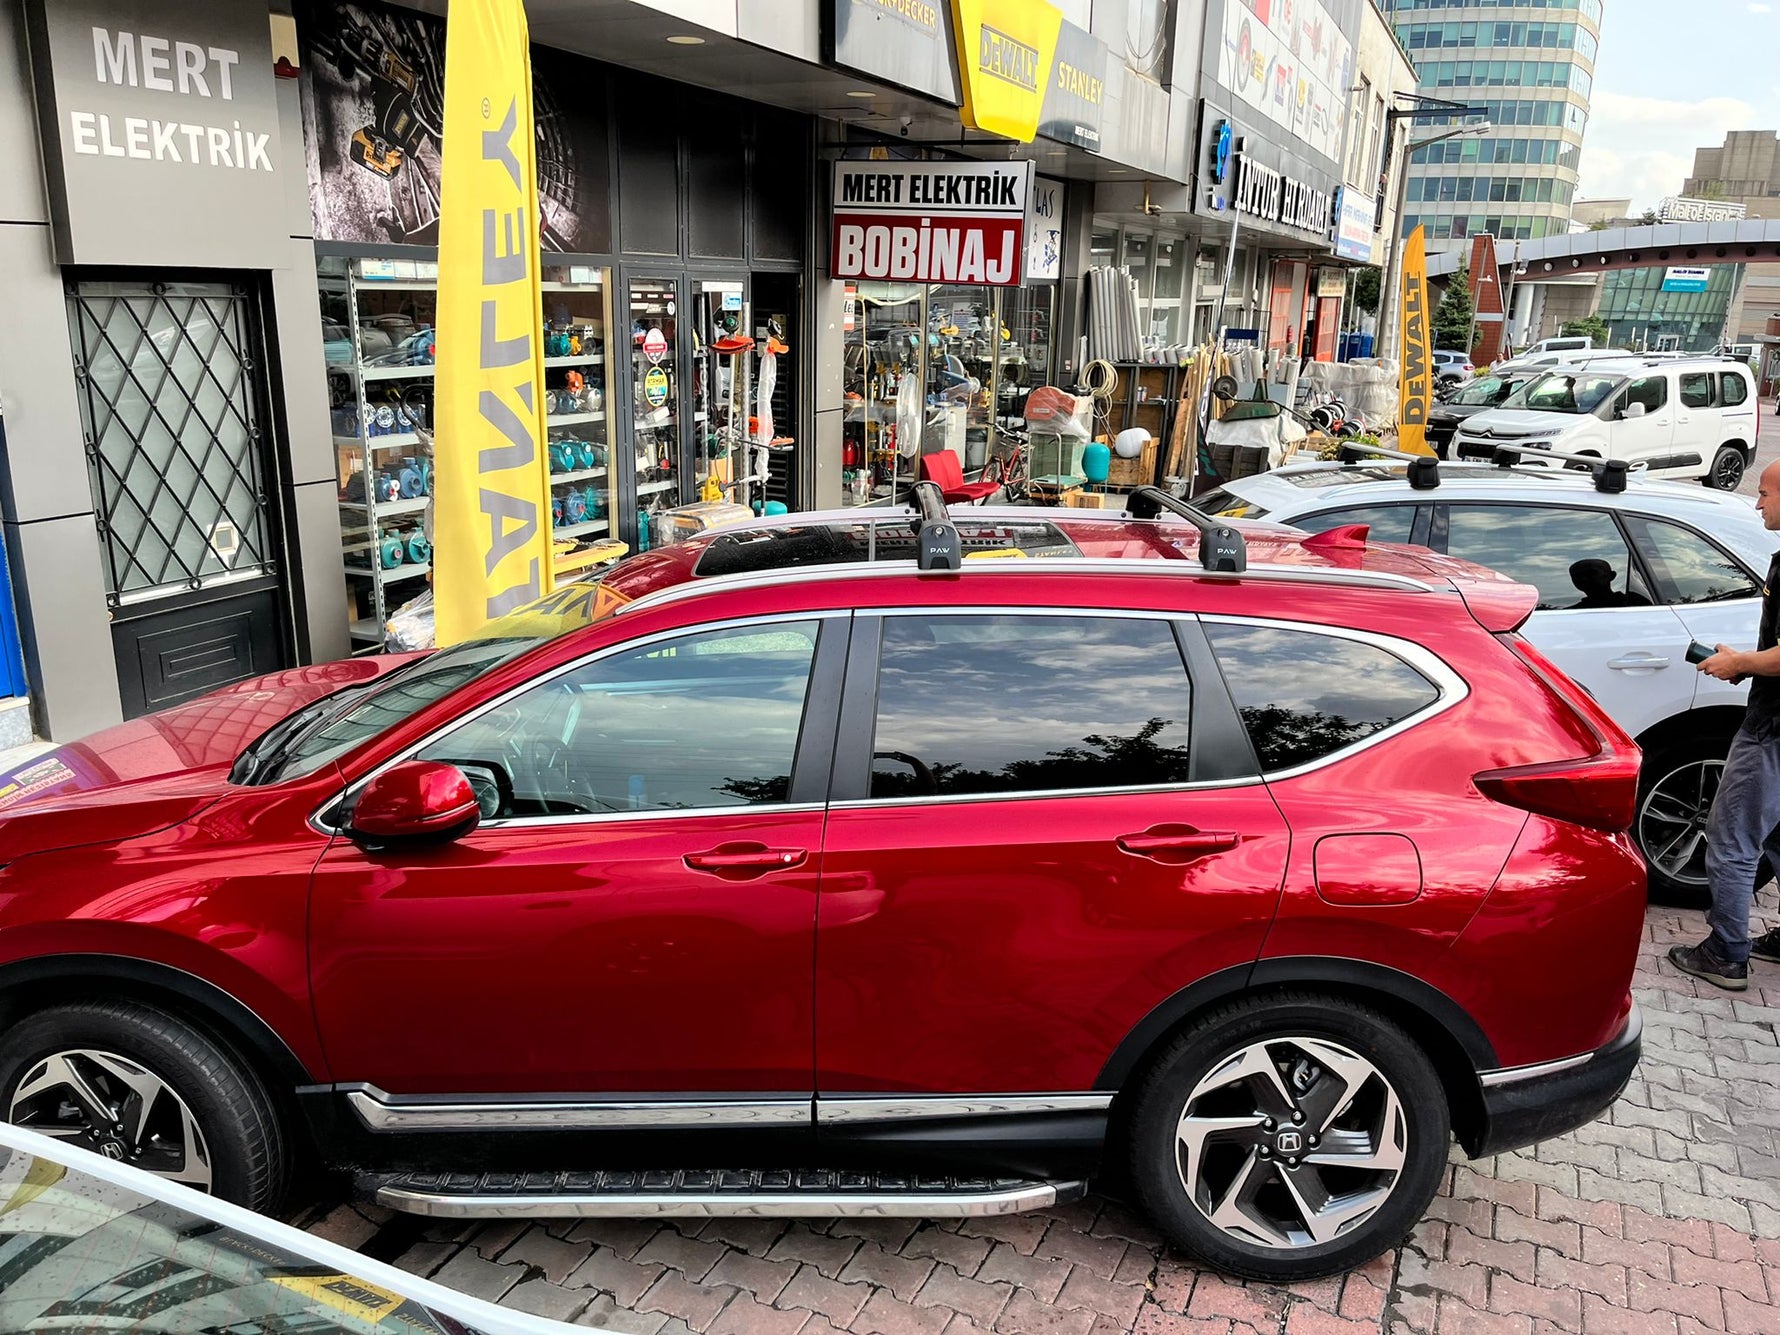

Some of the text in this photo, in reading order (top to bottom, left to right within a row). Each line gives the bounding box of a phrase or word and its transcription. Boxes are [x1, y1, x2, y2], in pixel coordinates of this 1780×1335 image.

[92, 26, 239, 101] MERT
[1058, 61, 1103, 105] STANLEY
[70, 111, 274, 172] ELEKTRİK
[843, 170, 1017, 206] MERT ELEKTRİK
[1033, 186, 1055, 219] LAS
[838, 218, 1015, 283] BOBİNAJ
[1403, 273, 1425, 426] DEWALT
